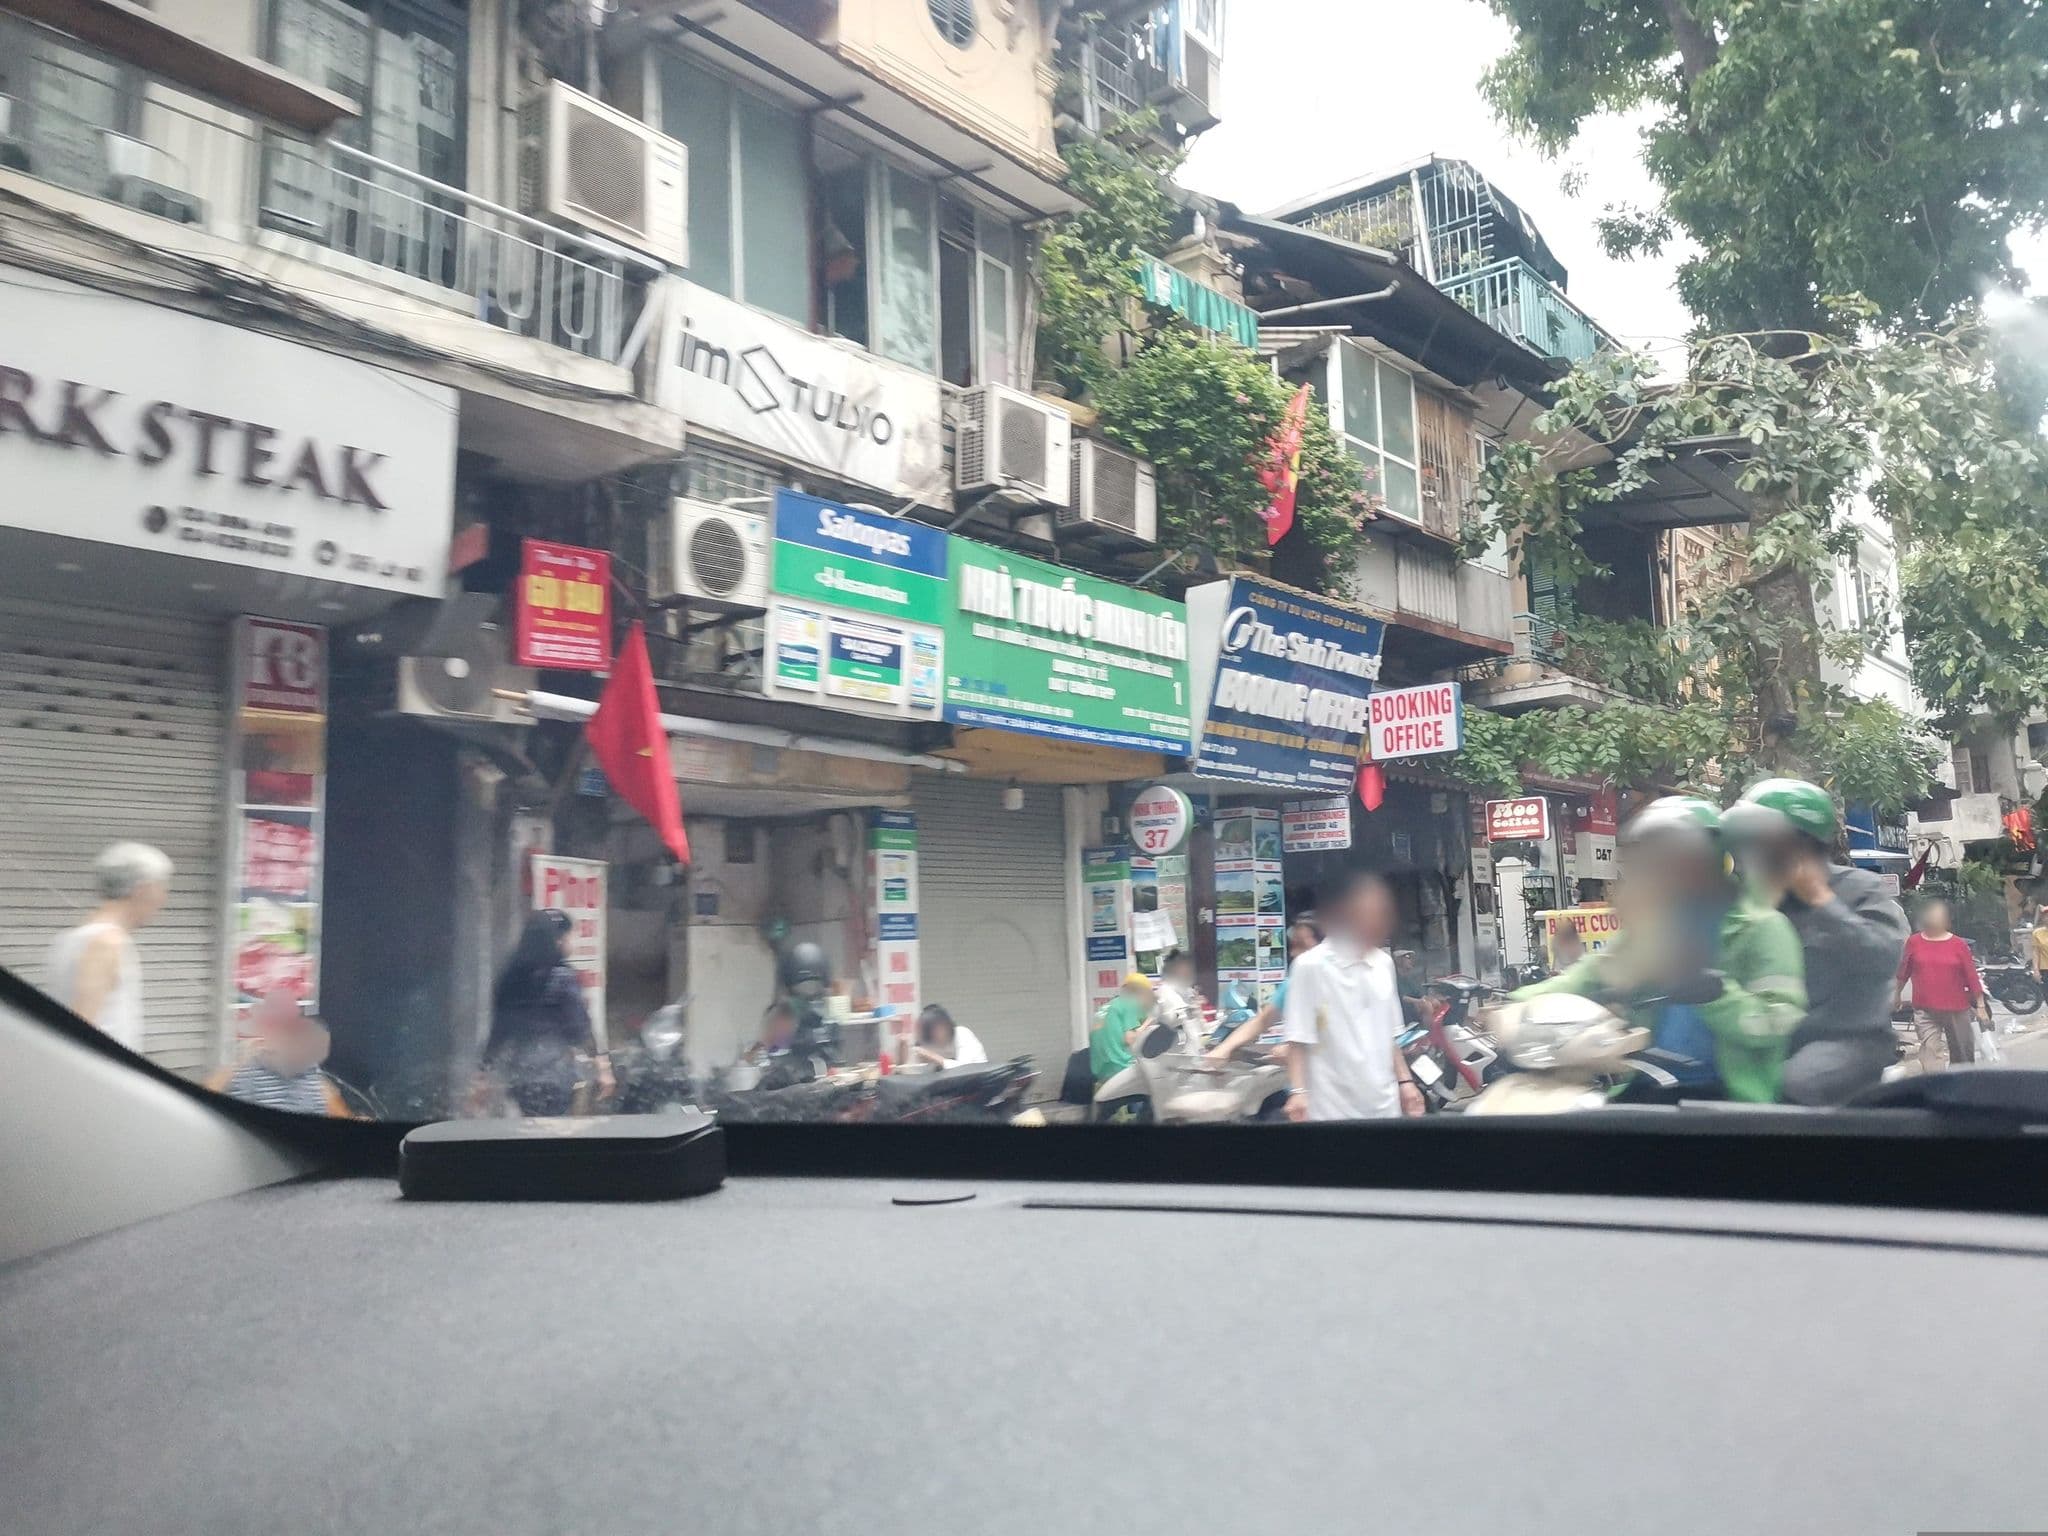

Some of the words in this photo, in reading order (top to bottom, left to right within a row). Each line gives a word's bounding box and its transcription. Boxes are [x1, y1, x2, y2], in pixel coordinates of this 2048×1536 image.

[140, 400, 391, 510] STEAK
[1250, 622, 1287, 658] The
[1214, 668, 1310, 723] BOOKING
[1372, 687, 1452, 724] BOOKING
[1384, 720, 1444, 753] OFFICE
[1492, 817, 1540, 828] Coffee
[1493, 803, 1539, 818] Moo
[1145, 829, 1169, 848] 37
[1596, 849, 1612, 861] D&T
[1549, 914, 1587, 935] BNH
